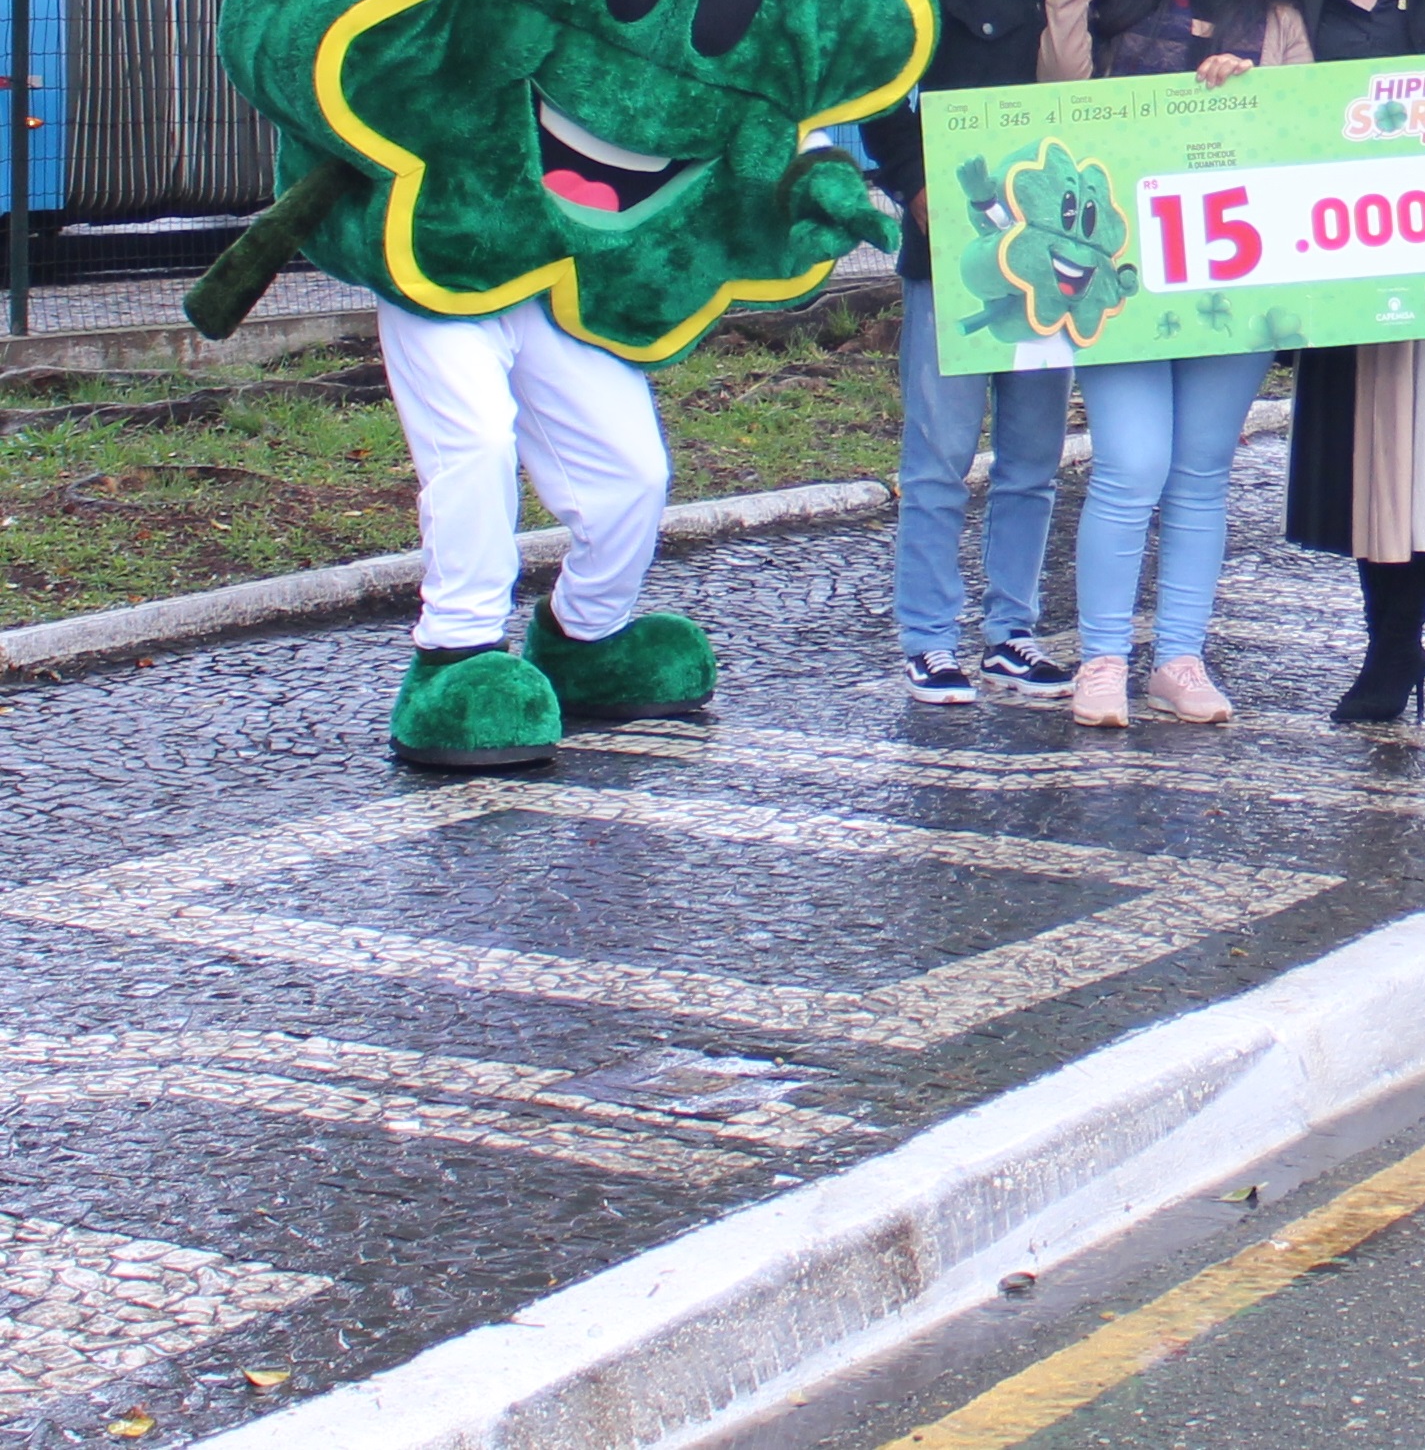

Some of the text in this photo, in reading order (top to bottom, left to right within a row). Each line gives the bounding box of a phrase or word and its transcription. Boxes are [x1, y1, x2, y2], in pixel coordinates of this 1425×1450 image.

[1071, 102, 1151, 123] 0123-4 8
[1165, 95, 1259, 115] 000123344
[948, 116, 979, 131] 012
[999, 110, 1057, 127] 345 4
[1143, 180, 1159, 190] R$
[1149, 185, 1263, 285] 15
